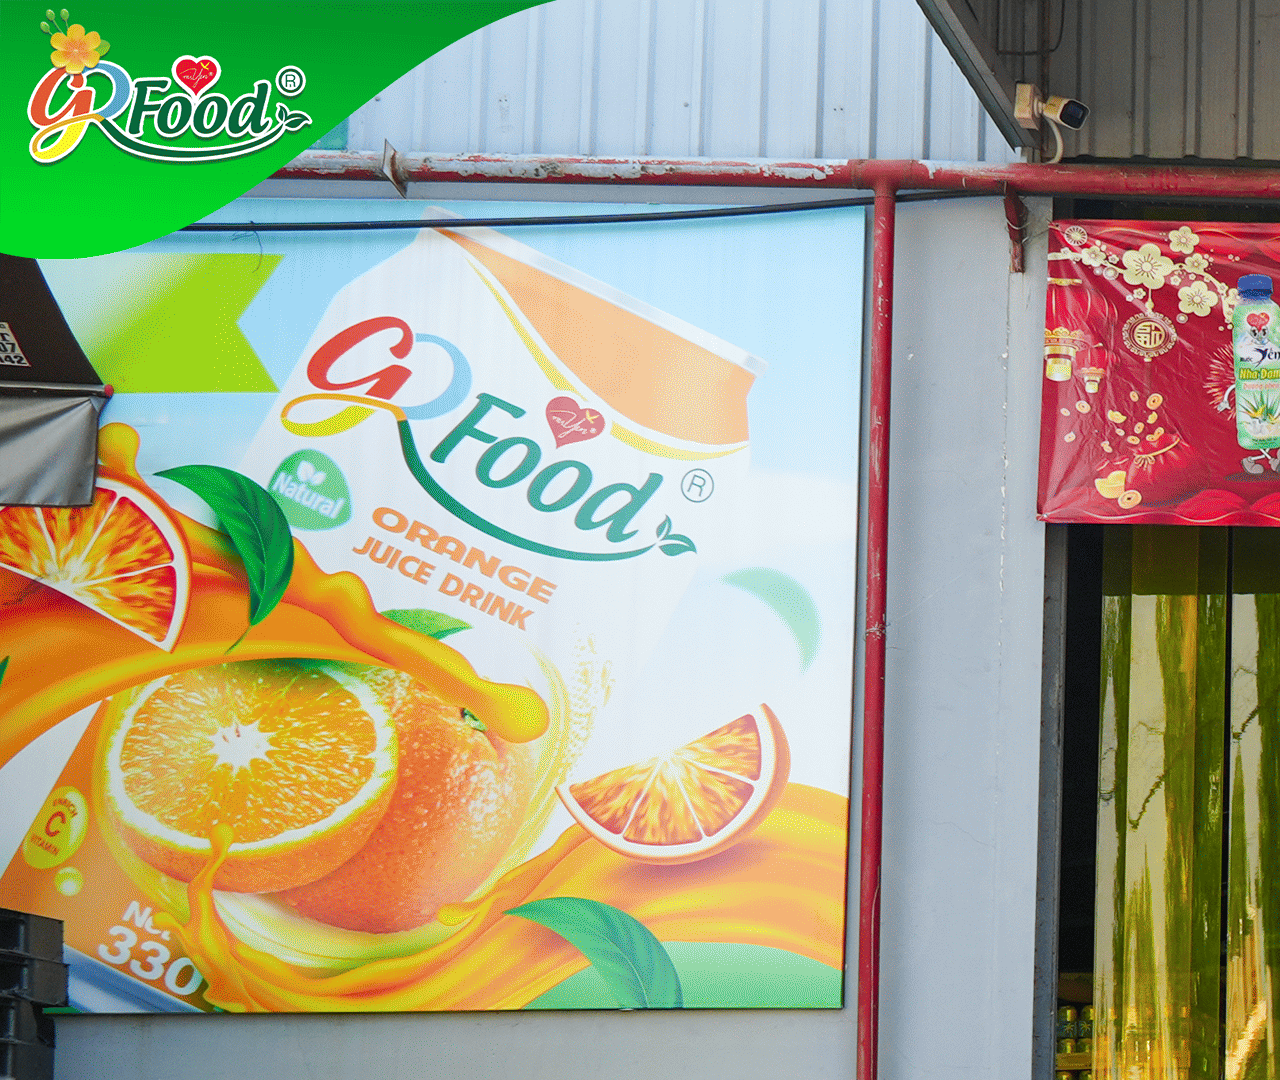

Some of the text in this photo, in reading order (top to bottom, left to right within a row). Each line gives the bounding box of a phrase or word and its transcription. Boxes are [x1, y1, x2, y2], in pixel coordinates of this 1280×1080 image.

[272, 472, 346, 520] Natural
[353, 536, 535, 631] JUICE DRINK
[372, 506, 558, 604] ORANGE
[45, 811, 67, 837] C
[98, 925, 204, 996] 330
